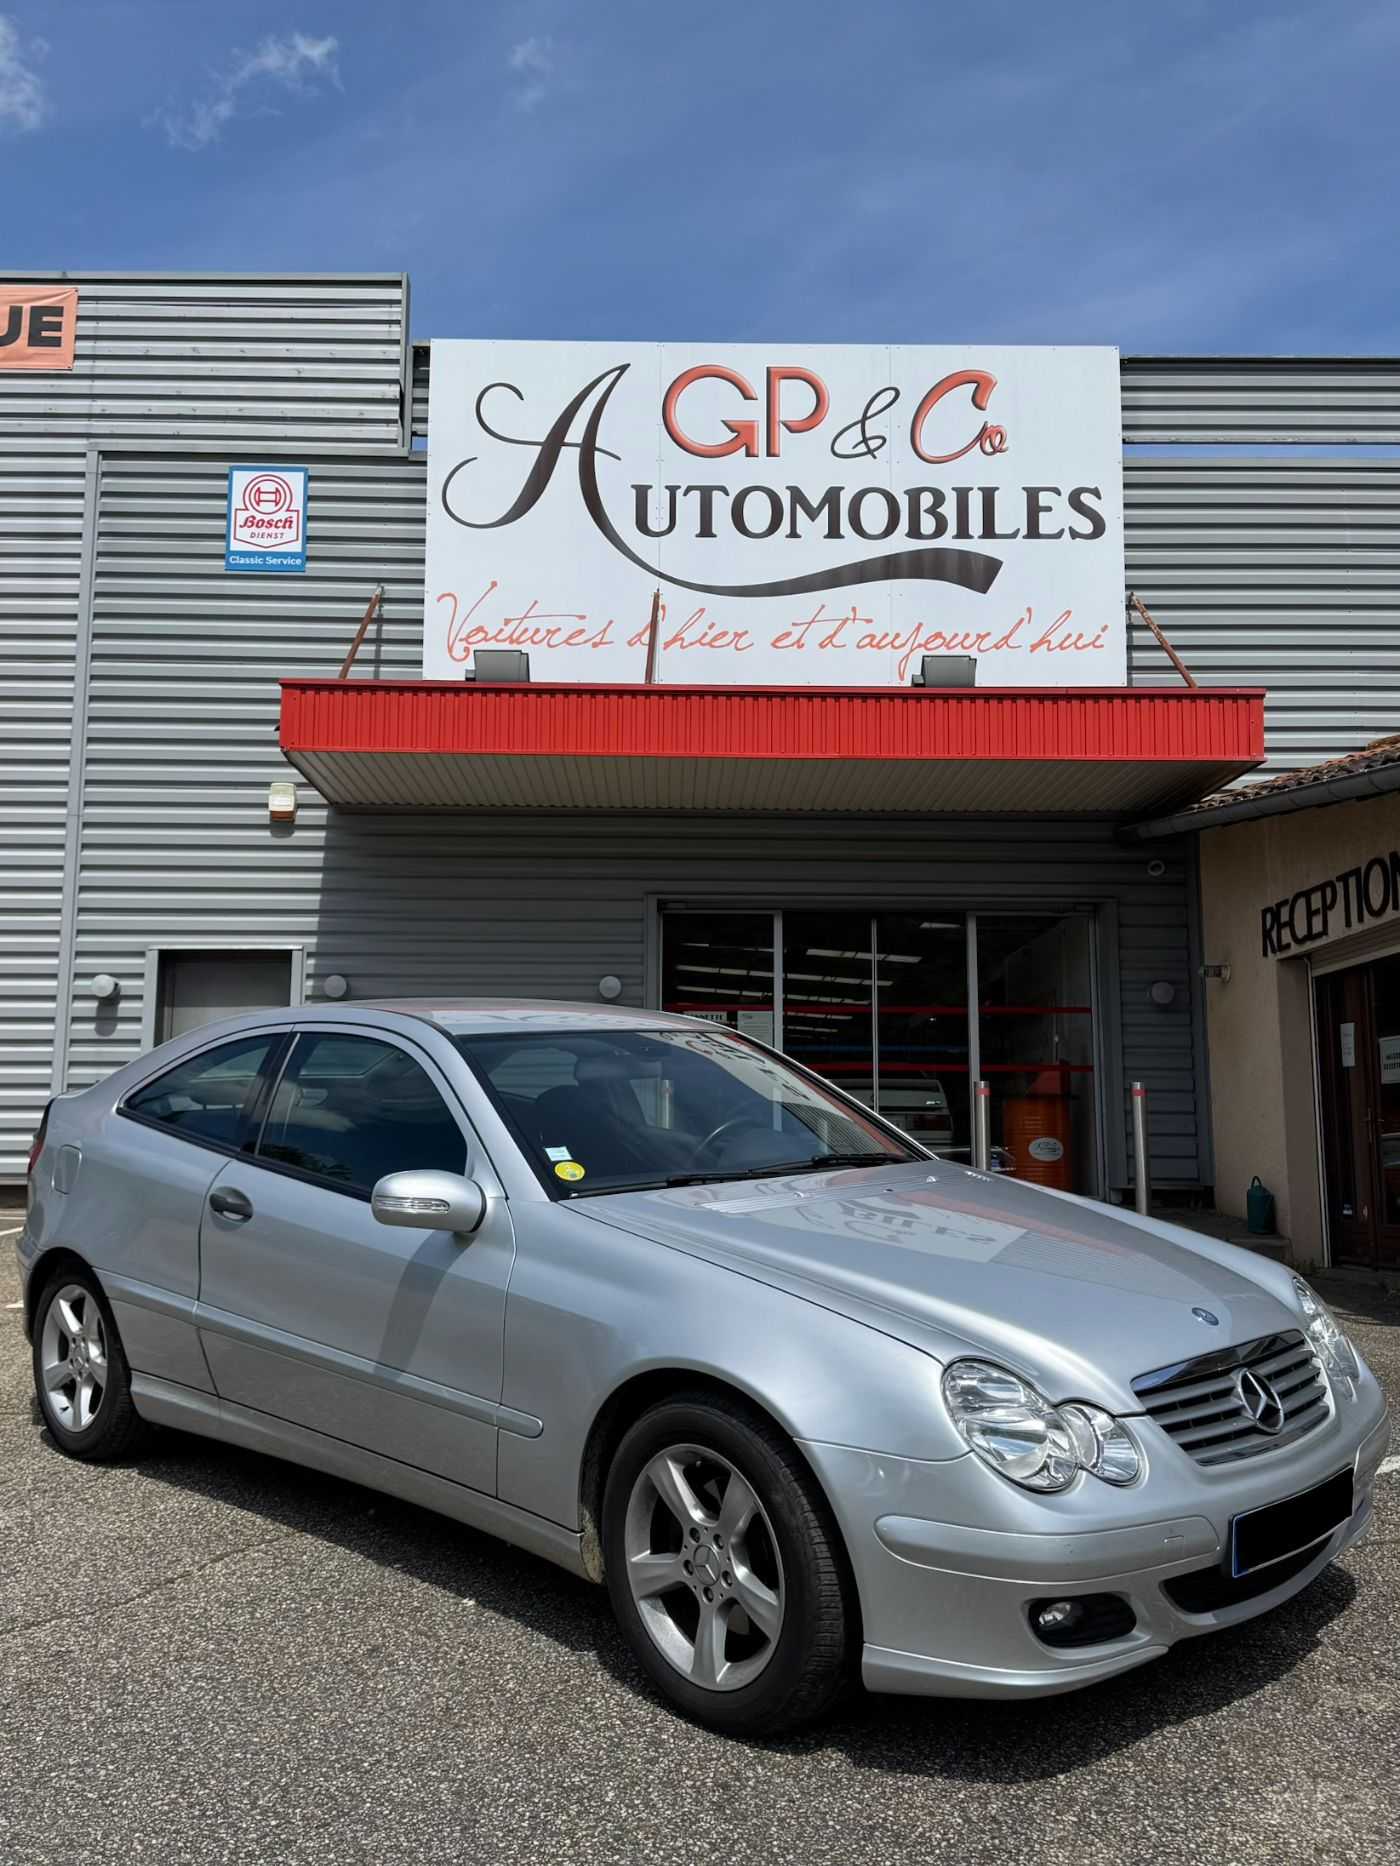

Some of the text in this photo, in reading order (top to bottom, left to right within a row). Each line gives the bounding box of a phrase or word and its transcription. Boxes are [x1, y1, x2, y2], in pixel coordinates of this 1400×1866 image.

[662, 365, 1009, 464] GP & Co
[441, 363, 1106, 597] AUTOMOBILES
[229, 555, 302, 566] Classic Service
[239, 515, 293, 529] Bosch
[437, 581, 614, 662] Voitures
